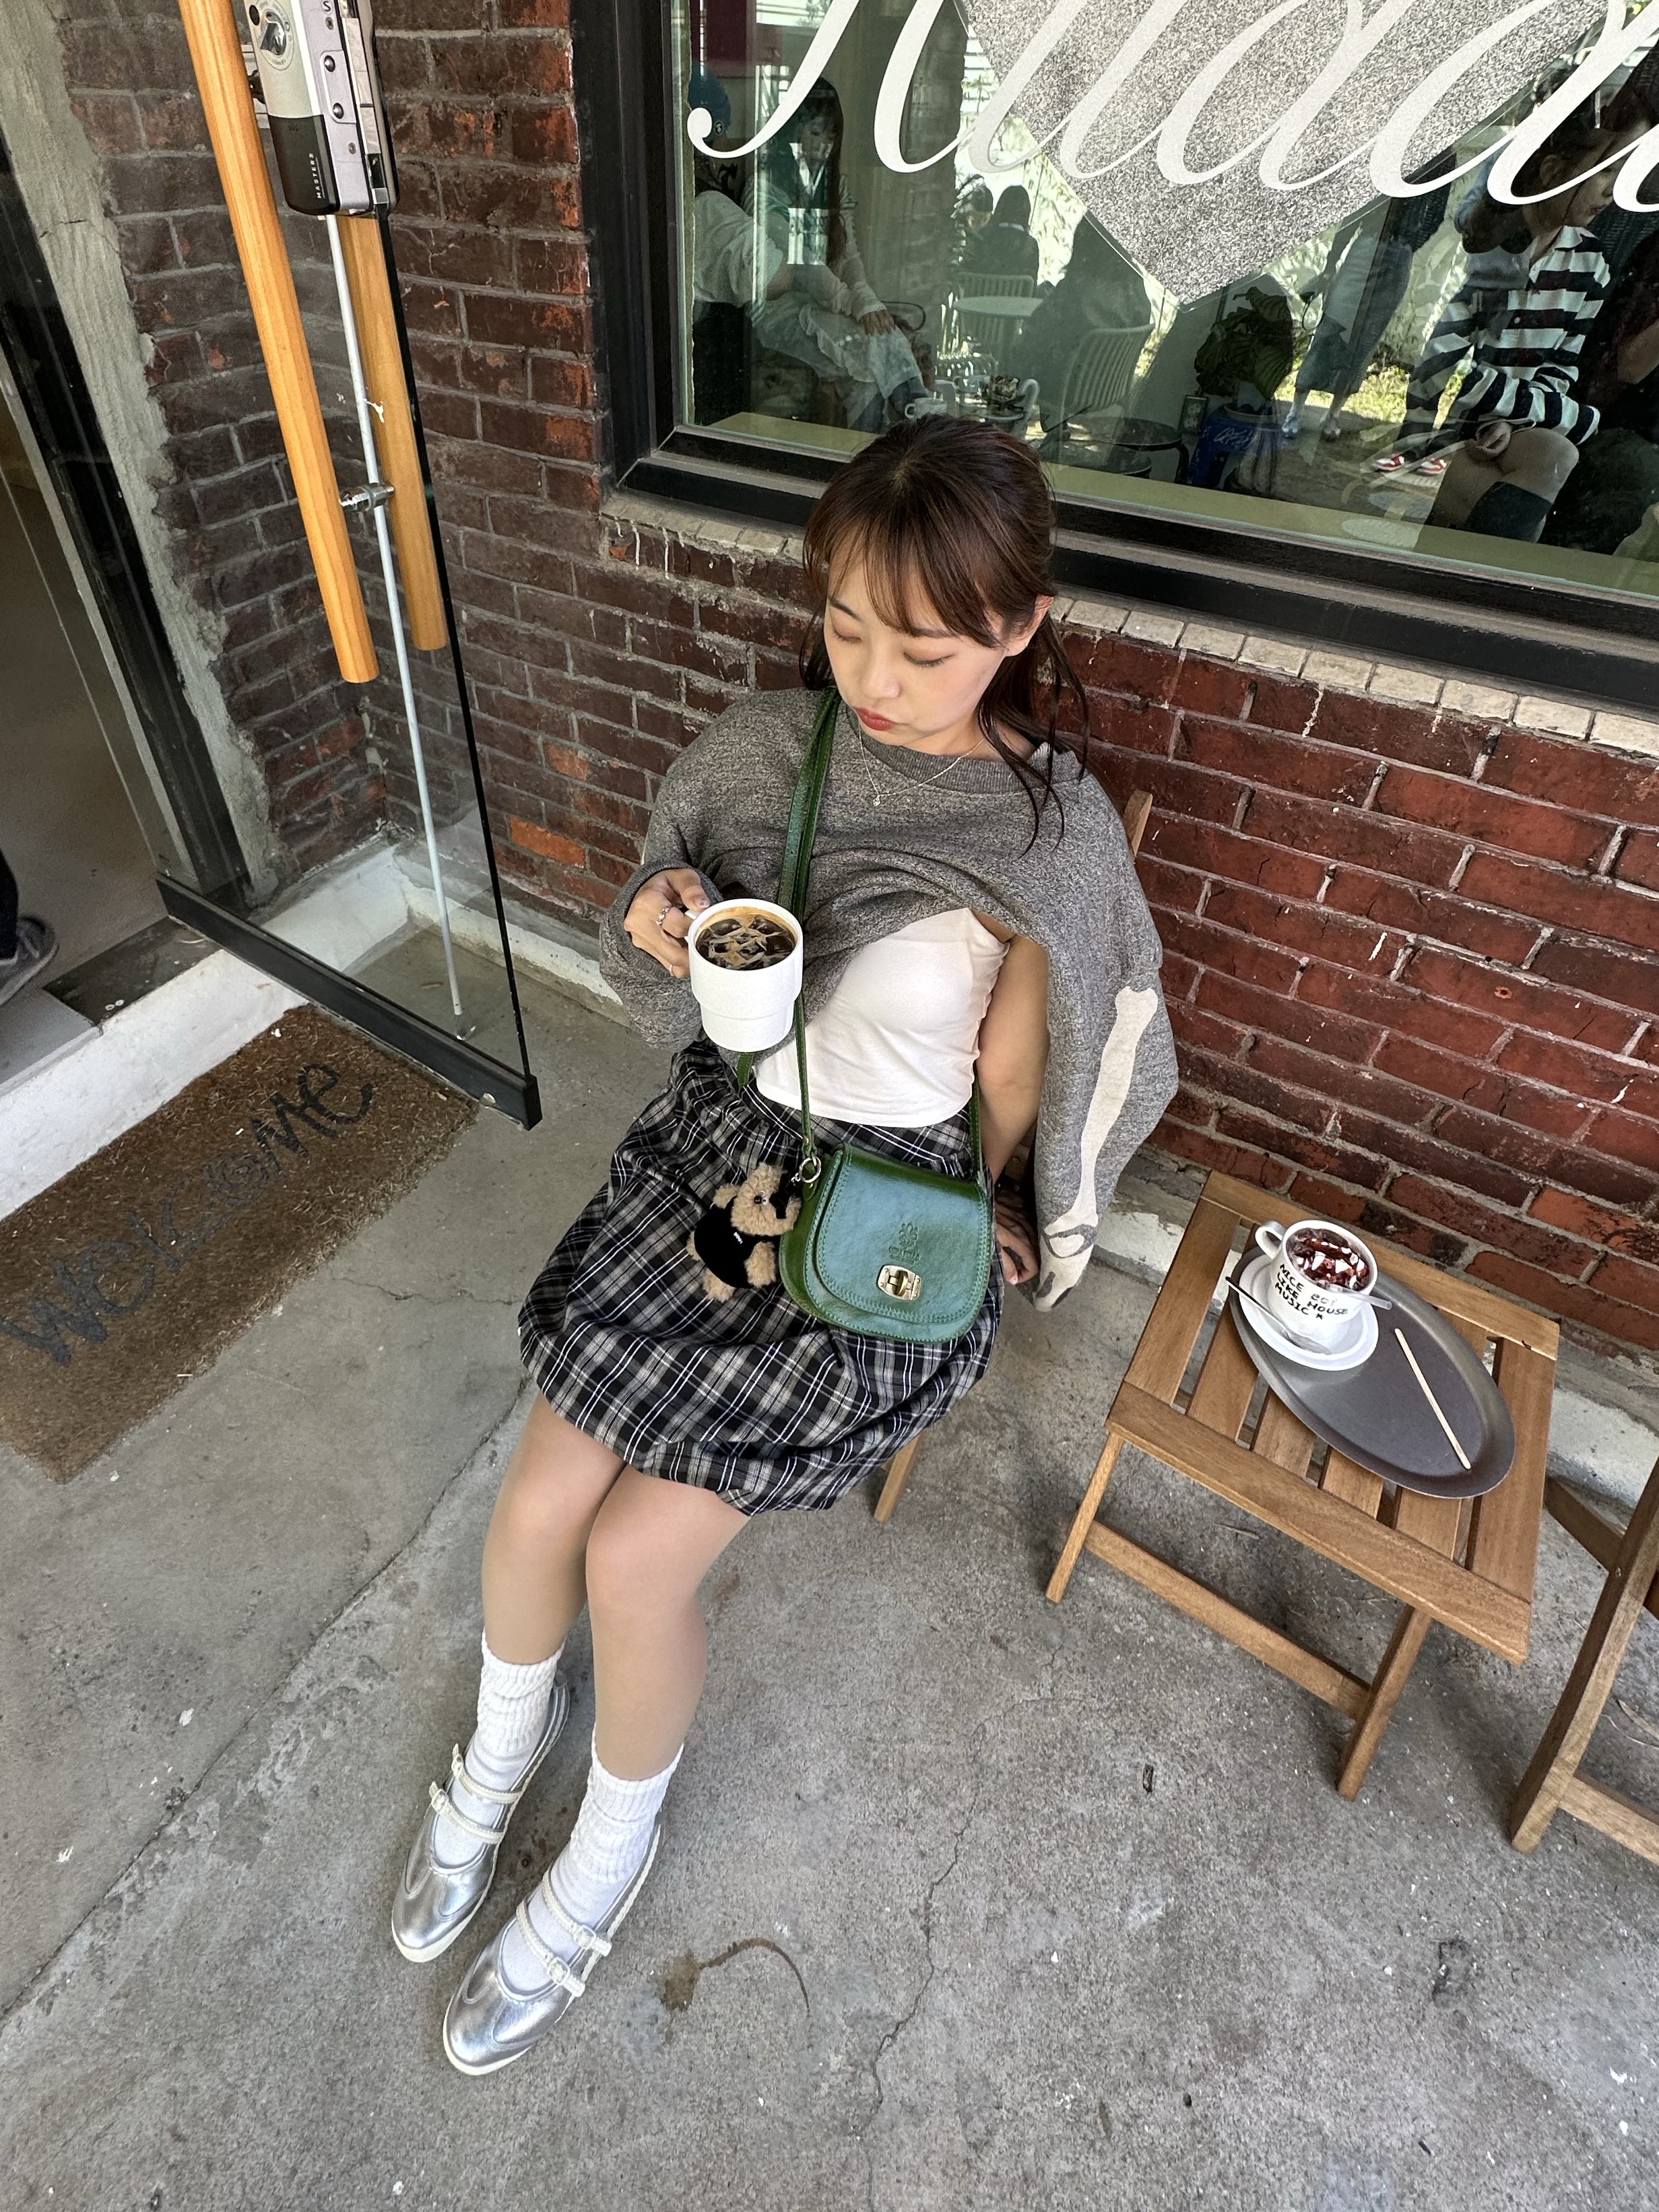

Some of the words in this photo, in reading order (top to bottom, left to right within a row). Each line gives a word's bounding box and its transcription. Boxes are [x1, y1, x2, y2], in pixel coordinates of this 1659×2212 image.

[323, 1, 331, 12] S
[308, 153, 322, 199] MASTERS
[1277, 1272, 1299, 1300] LIKE
[1307, 1301, 1348, 1315] HOUSE
[1280, 1264, 1305, 1293] NICE
[1275, 1282, 1309, 1315] MUSIC
